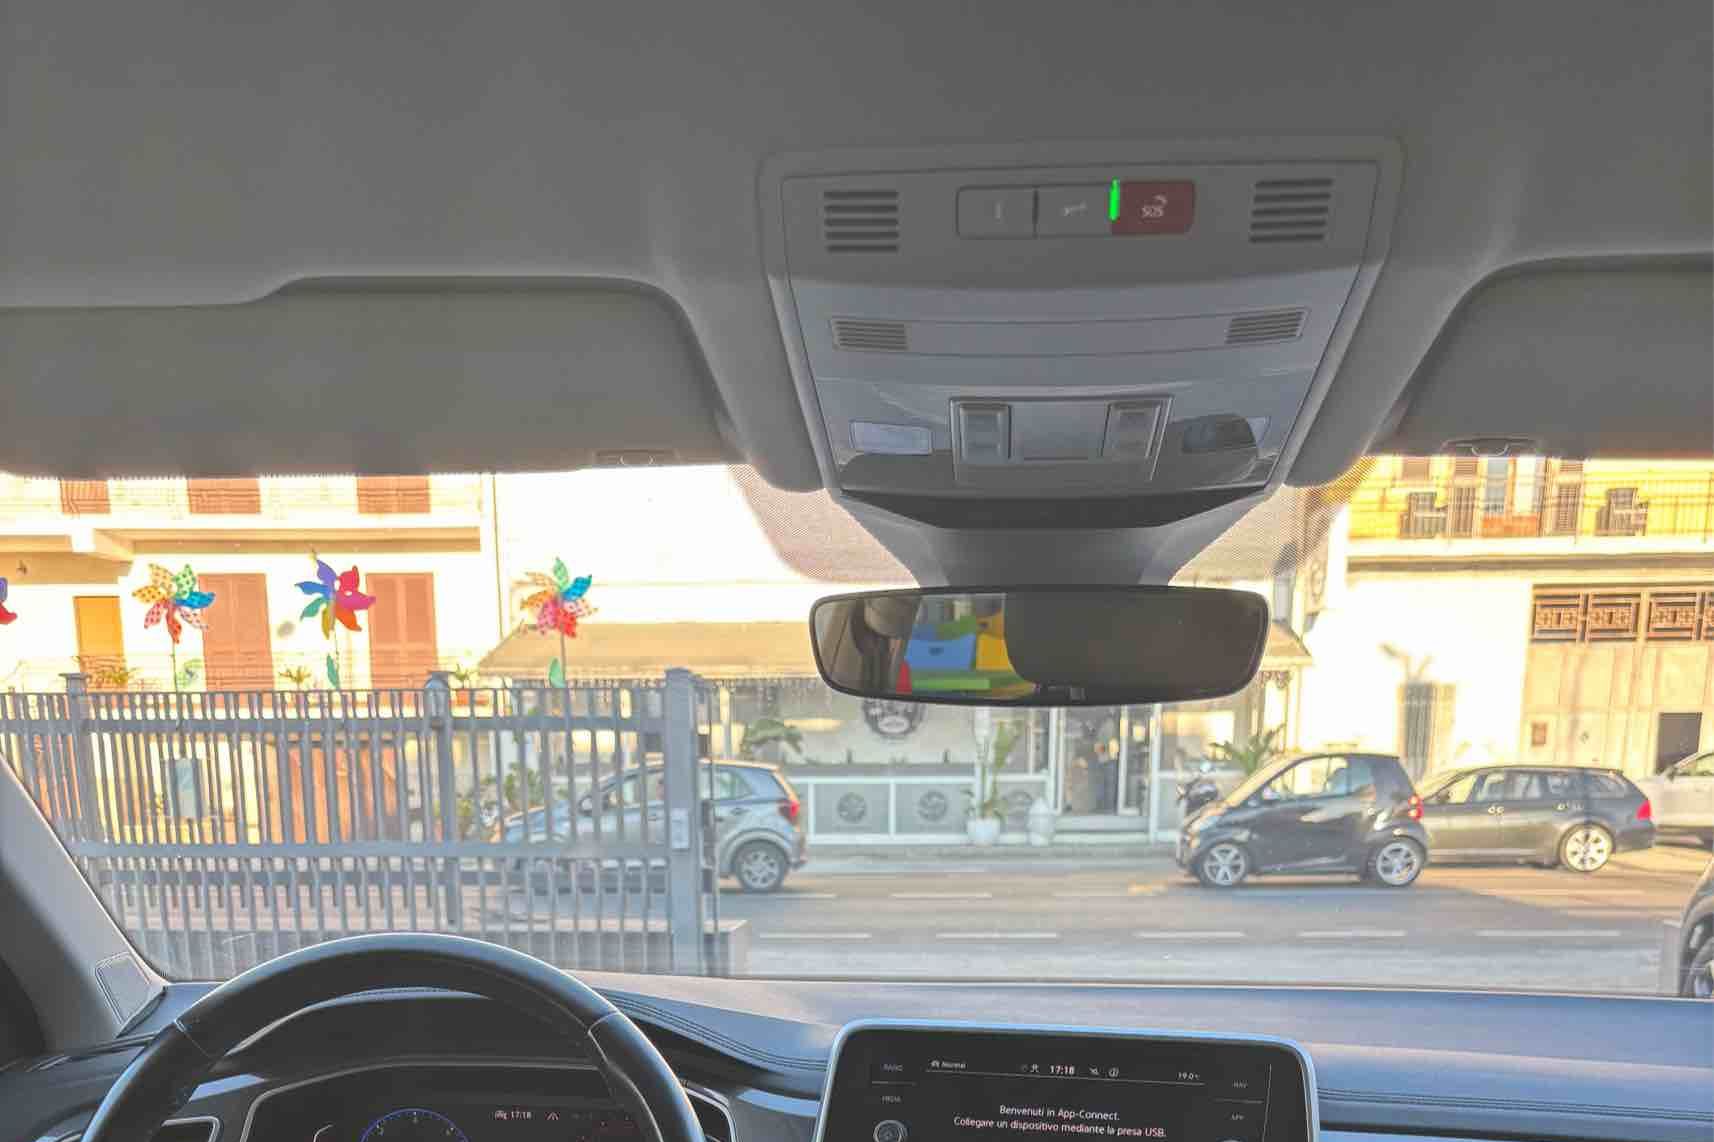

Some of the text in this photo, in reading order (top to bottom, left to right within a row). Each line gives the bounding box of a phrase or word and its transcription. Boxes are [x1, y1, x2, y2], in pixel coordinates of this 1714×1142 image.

[1141, 206, 1164, 218] SOS
[1049, 1065, 1076, 1076] 17:18
[511, 1110, 532, 1120] 17:18
[999, 1104, 1120, 1122] Benvenuti in App-Connect.
[953, 1115, 1167, 1139] Collegare un dispositivo mediante la presa USB.
